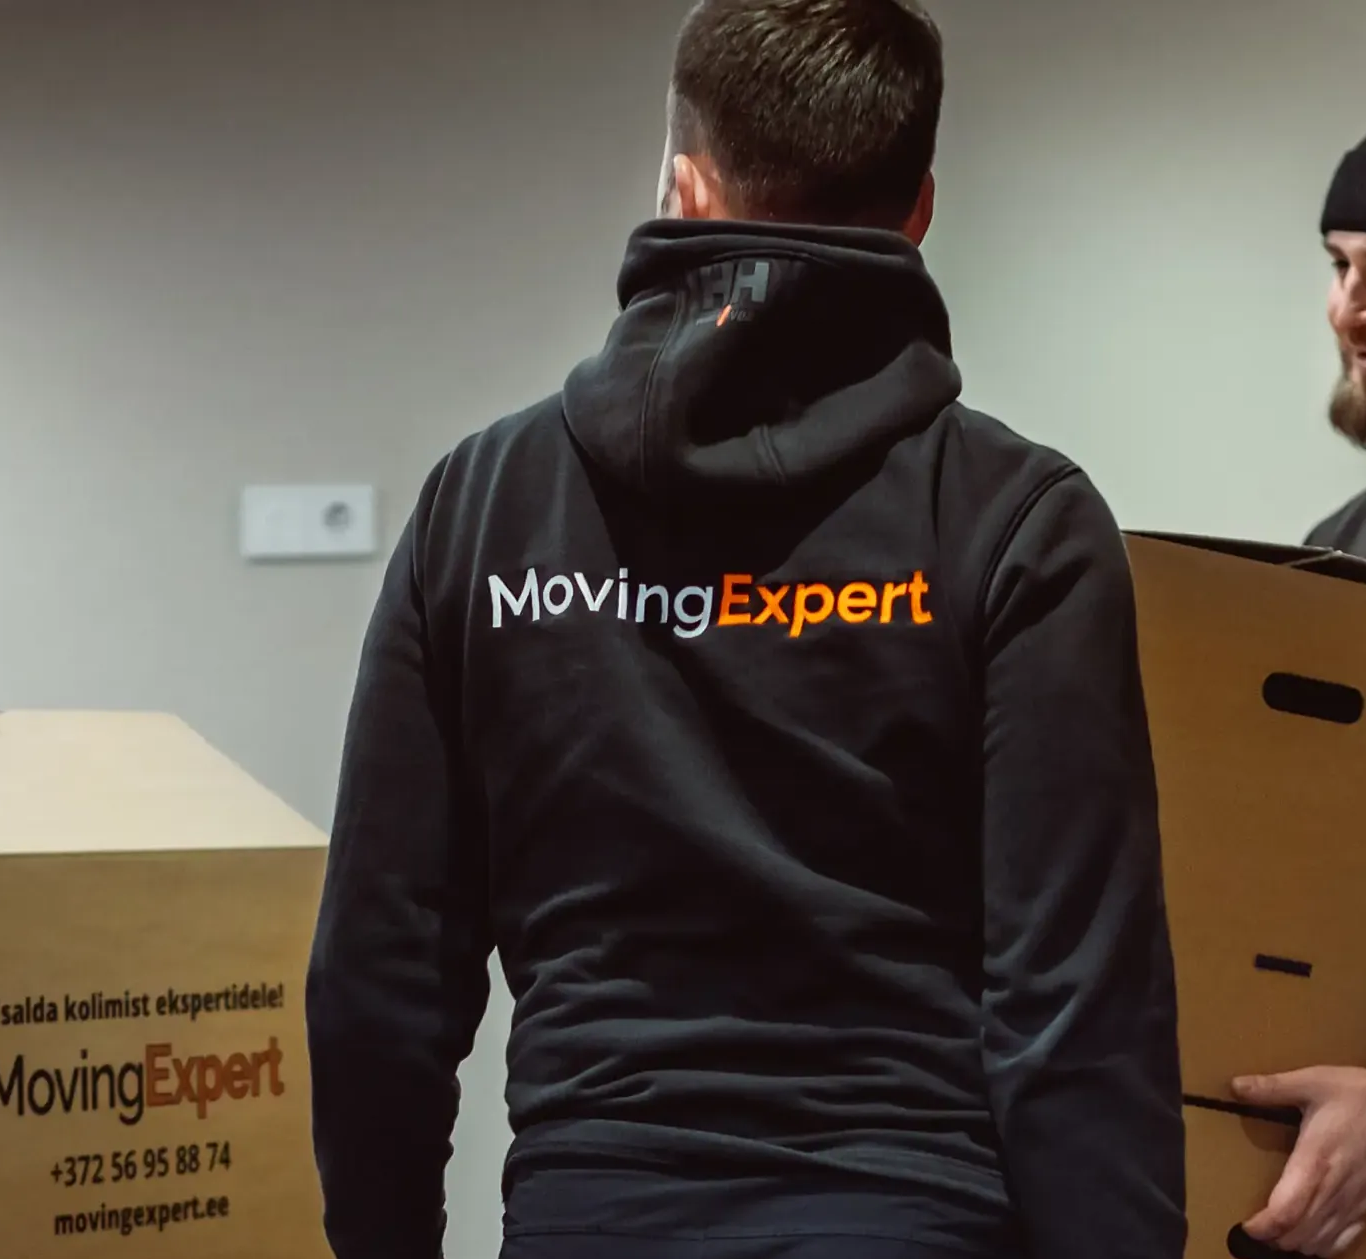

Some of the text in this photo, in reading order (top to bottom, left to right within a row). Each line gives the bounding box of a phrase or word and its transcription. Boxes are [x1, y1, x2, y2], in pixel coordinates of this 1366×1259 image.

[488, 566, 933, 639] MovingExpert
[64, 990, 151, 1023] kolimist
[155, 981, 285, 1021] ekspertidele!
[50, 1140, 232, 1187] +372 56 95 88 74
[53, 1194, 230, 1237] movingexpert.ee
